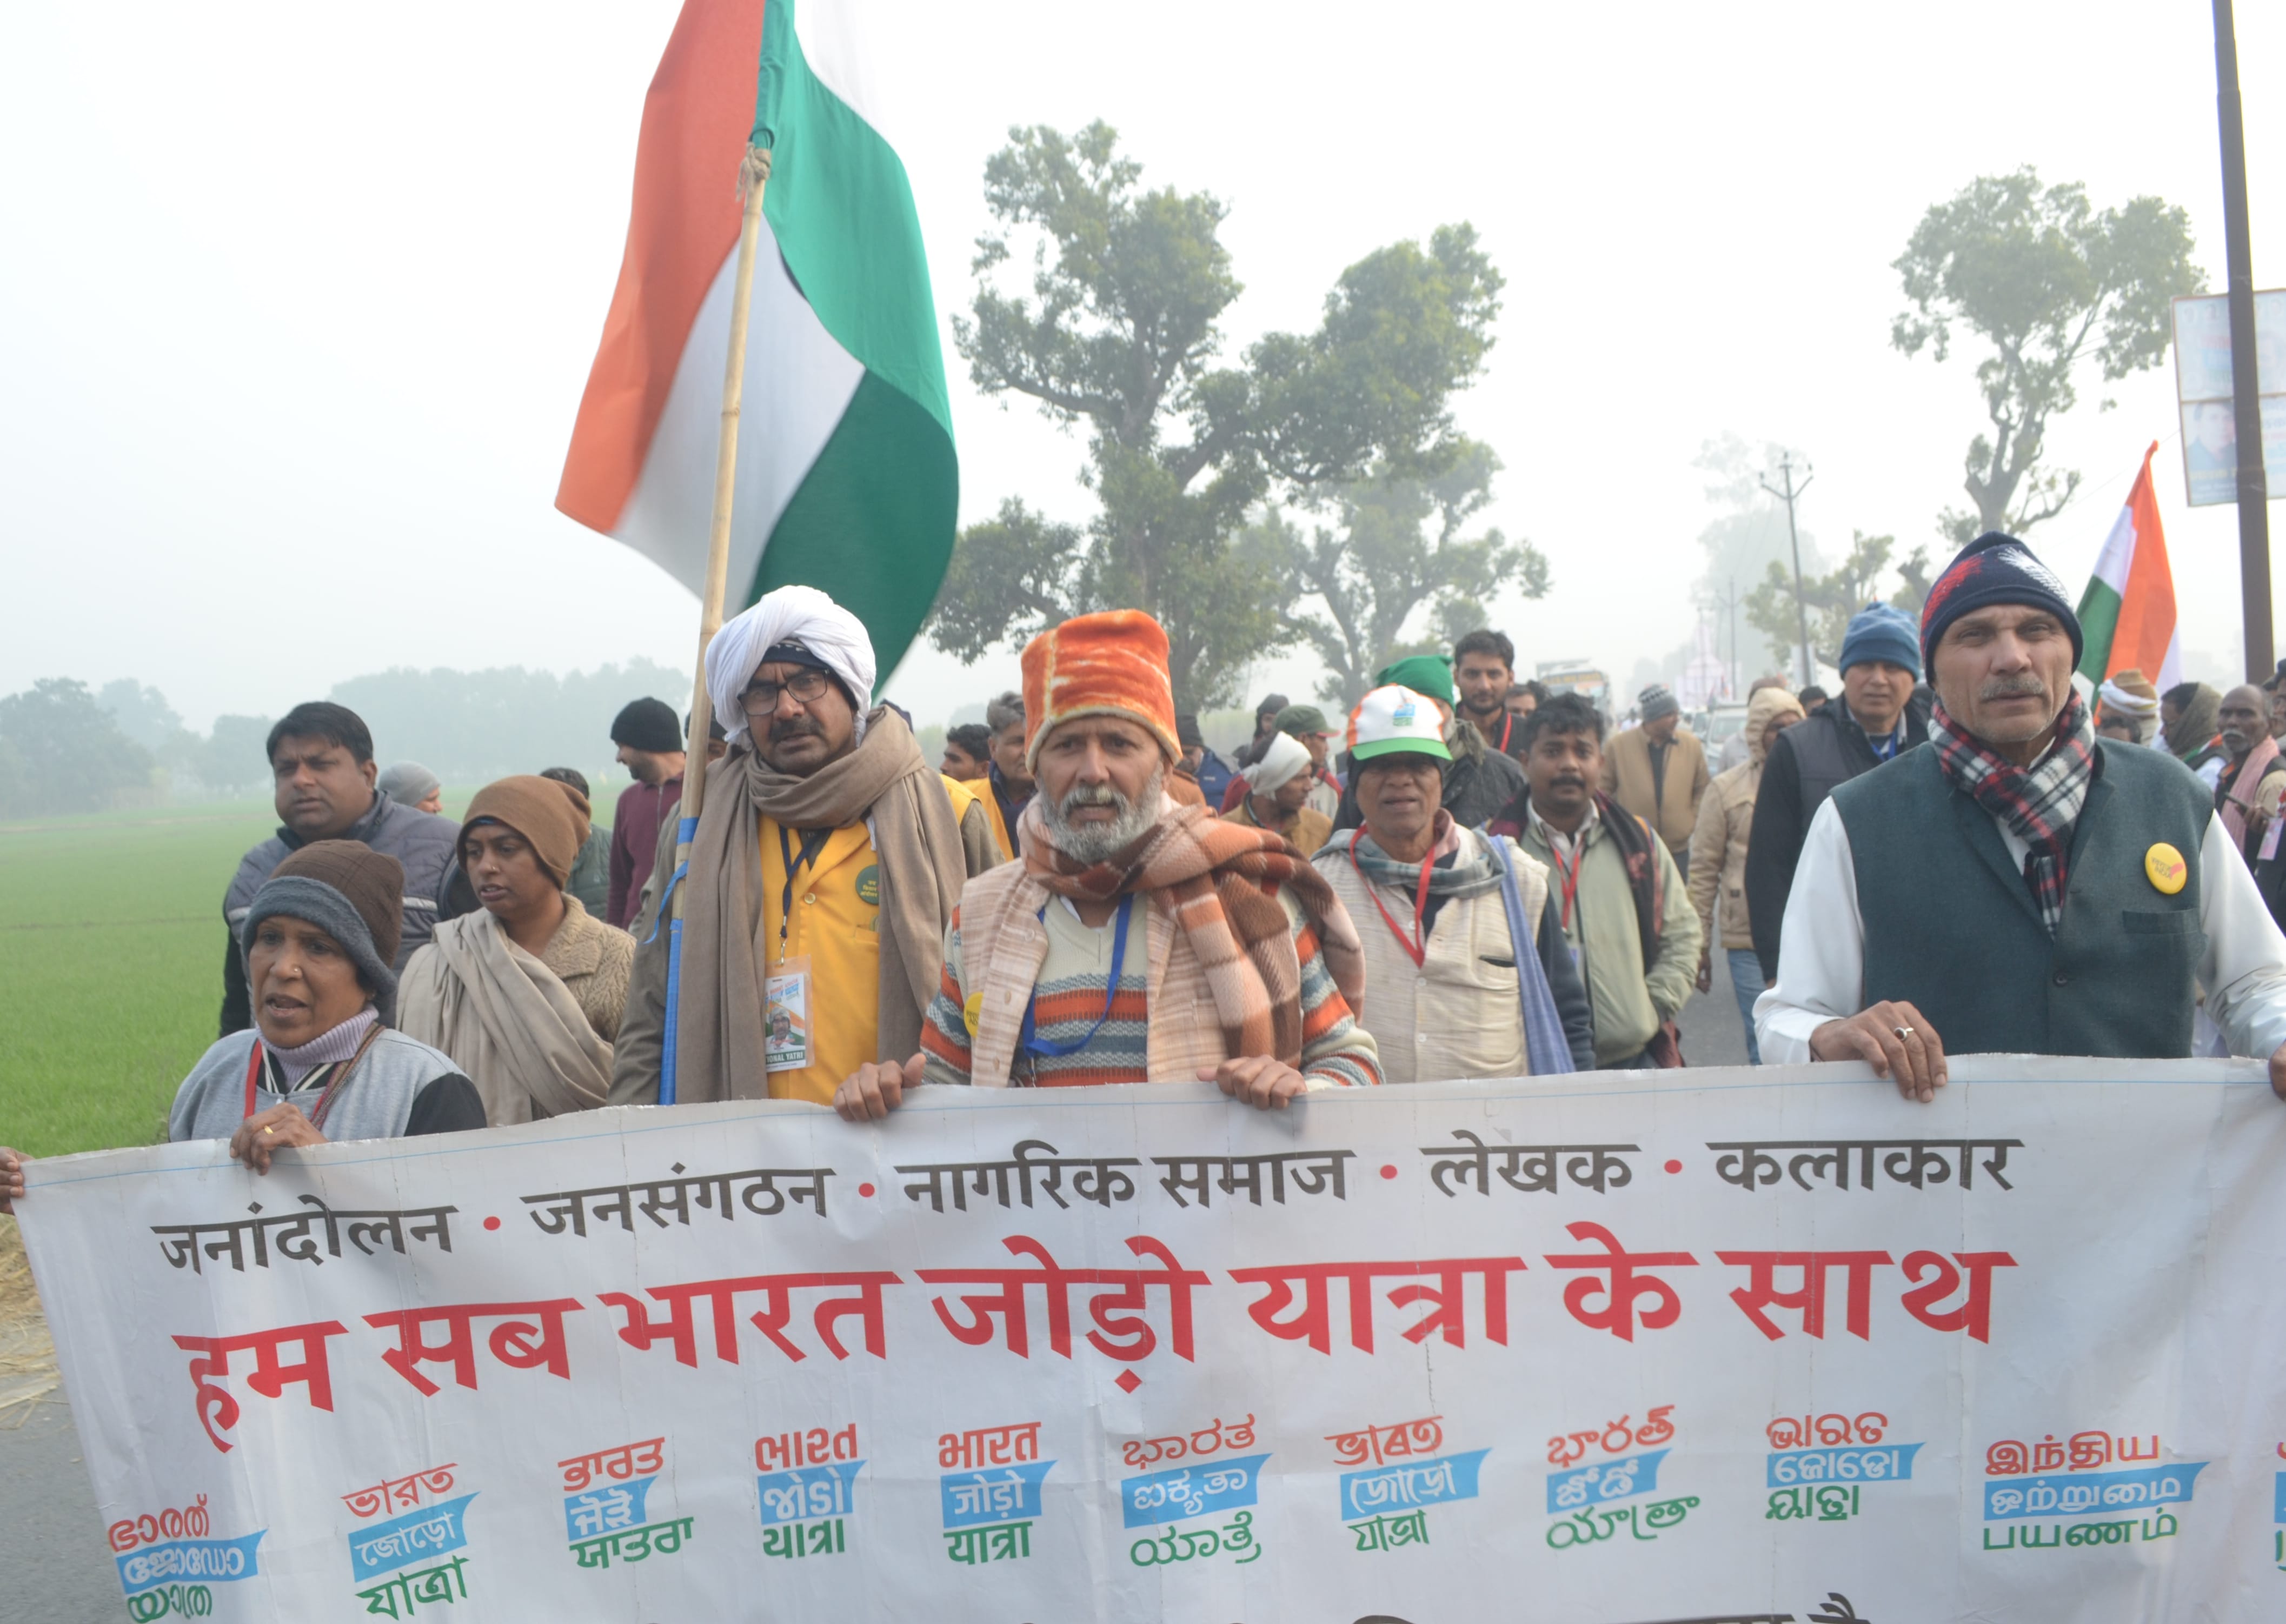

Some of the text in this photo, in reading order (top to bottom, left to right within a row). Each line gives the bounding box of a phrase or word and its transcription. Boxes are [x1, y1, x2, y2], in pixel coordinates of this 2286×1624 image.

[766, 1051, 803, 1063] IONAL YATRI
[149, 1130, 2024, 1275] जनांदोलन जनसंगठन नागरिक समाज लेखक कलाकार
[172, 1221, 2017, 1453] हम सब भारत जोड़ो यात्रा के साथ
[756, 1424, 857, 1471] ભારત
[940, 1422, 1041, 1468] भारत
[1124, 1414, 1255, 1469] ಭಾರತ
[1549, 1406, 1674, 1467] భారత్
[1767, 1413, 1888, 1449] ଭାରତ
[1986, 1431, 2158, 1475] இந்திய
[559, 1437, 664, 1491] ਭਾਰਤ
[343, 1463, 456, 1517] ভারত
[763, 1466, 843, 1520] જોડો
[949, 1469, 1026, 1518] जोड़ो
[1134, 1469, 1248, 1515] ಐಕ್ಯತಾ
[1990, 1477, 2182, 1515] ஒற்றுமை
[109, 1495, 209, 1551] ഭാരത്
[569, 1517, 694, 1569] ਯਾਤਰਾ
[763, 1519, 845, 1559] યાત્રા
[943, 1521, 1033, 1565] यात्रा
[1131, 1511, 1261, 1567] ಯಾತ್ರೆ
[1984, 1507, 2178, 1550] பயணம்
[124, 1548, 244, 1584] ജോഡോ
[357, 1556, 468, 1620] যাত্রা
[128, 1584, 212, 1623] യാത്ര
